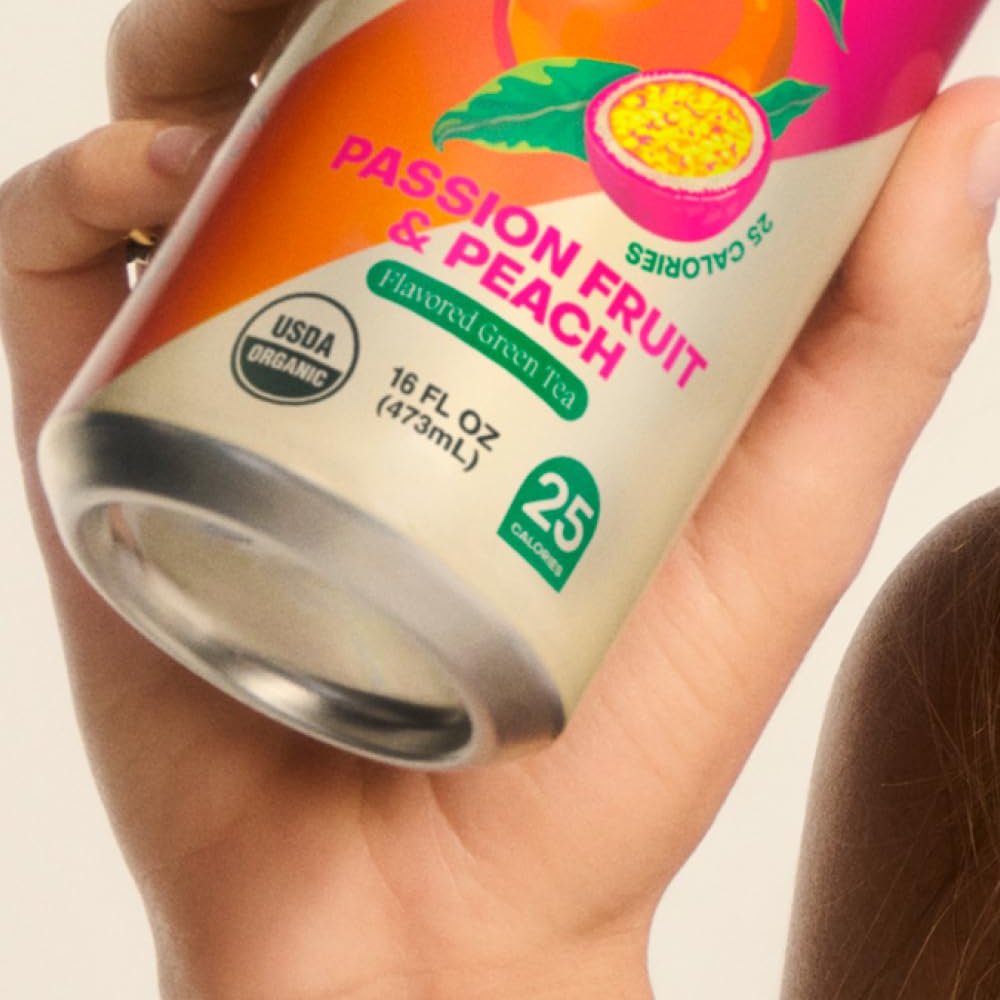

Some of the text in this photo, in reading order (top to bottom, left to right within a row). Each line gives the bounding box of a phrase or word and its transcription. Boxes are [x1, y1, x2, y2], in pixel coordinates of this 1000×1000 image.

[330, 135, 709, 390] PASSION FRUIT
[625, 212, 774, 279] 25 CALORIES
[387, 210, 628, 380] & PEACH
[247, 343, 329, 389] ORGANIC
[271, 314, 337, 358] USDA
[378, 266, 577, 411] Flavored Green Tea
[376, 395, 480, 472] (473mL)
[389, 366, 501, 452] 16 FL OZ
[510, 522, 564, 579] CALORIES
[522, 472, 596, 553] 25
